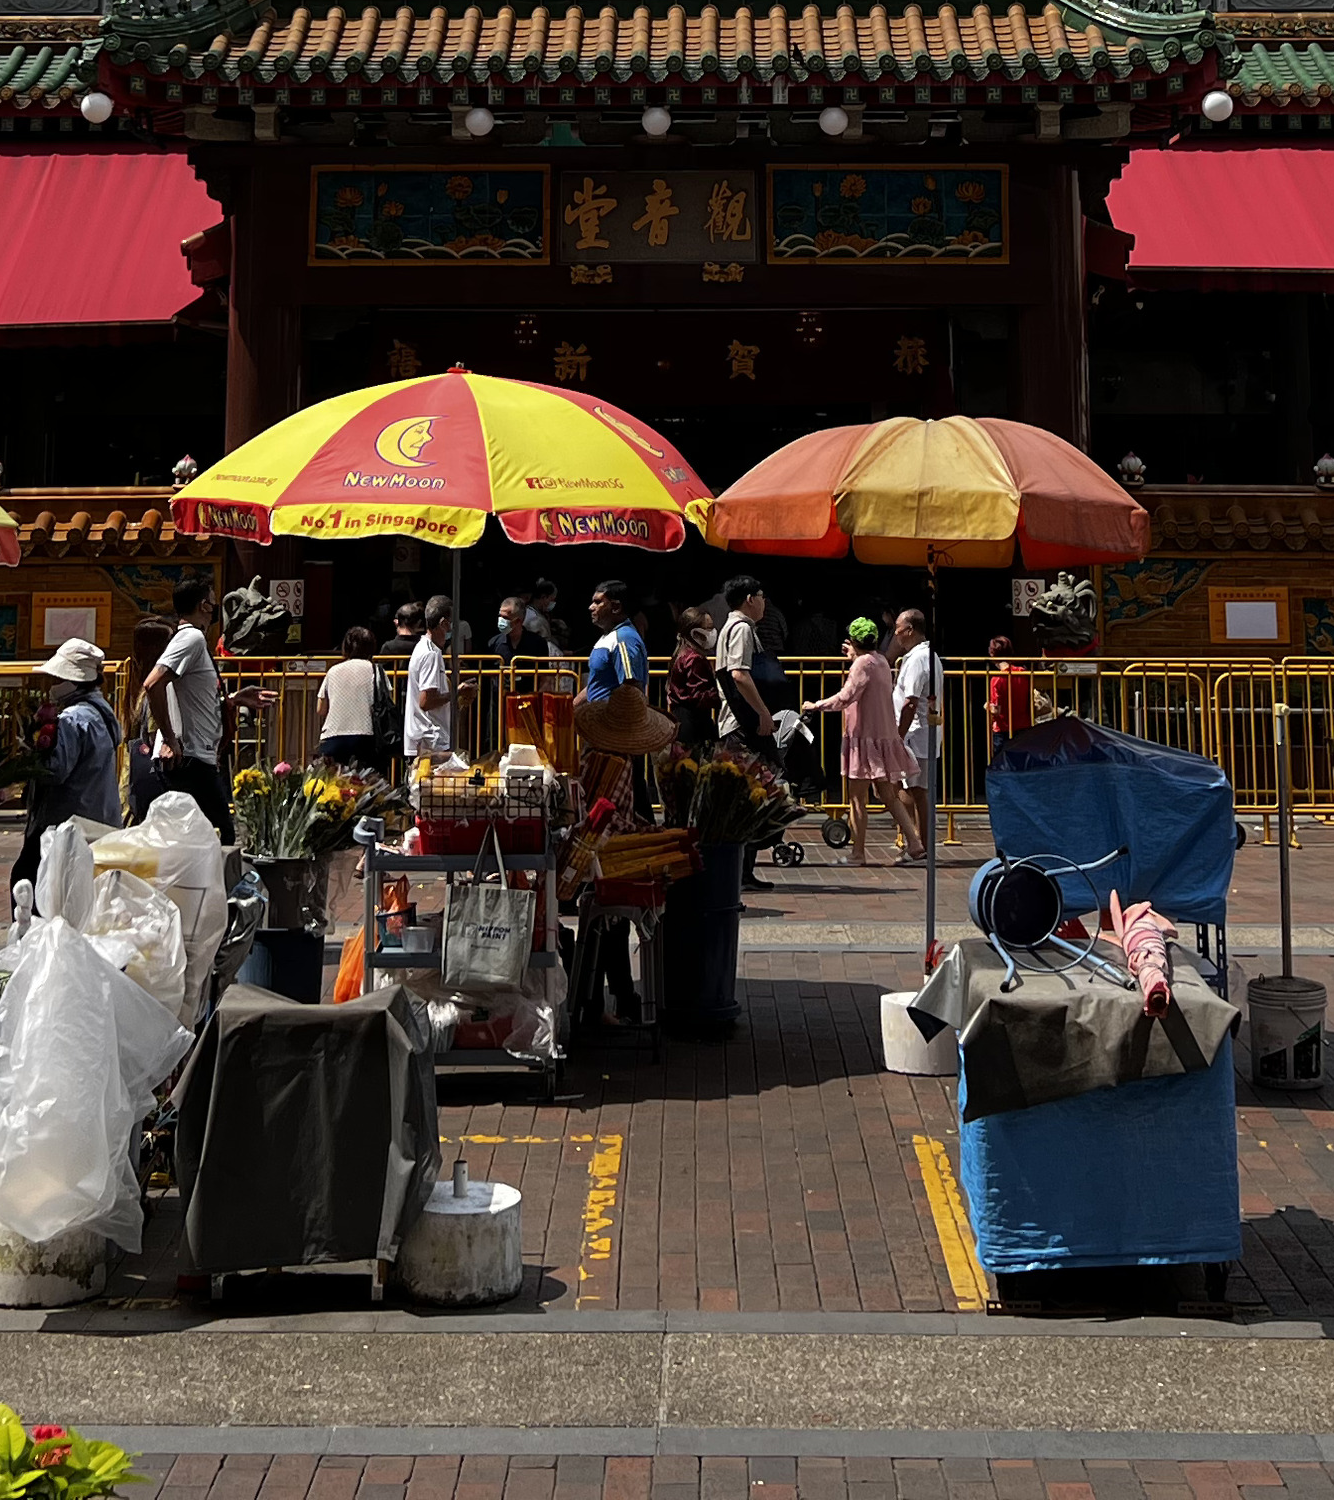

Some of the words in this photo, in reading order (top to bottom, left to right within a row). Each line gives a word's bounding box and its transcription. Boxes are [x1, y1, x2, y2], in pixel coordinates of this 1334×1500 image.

[557, 477, 625, 490] NewMoonSG
[345, 517, 361, 529] in
[365, 514, 458, 536] Singapore
